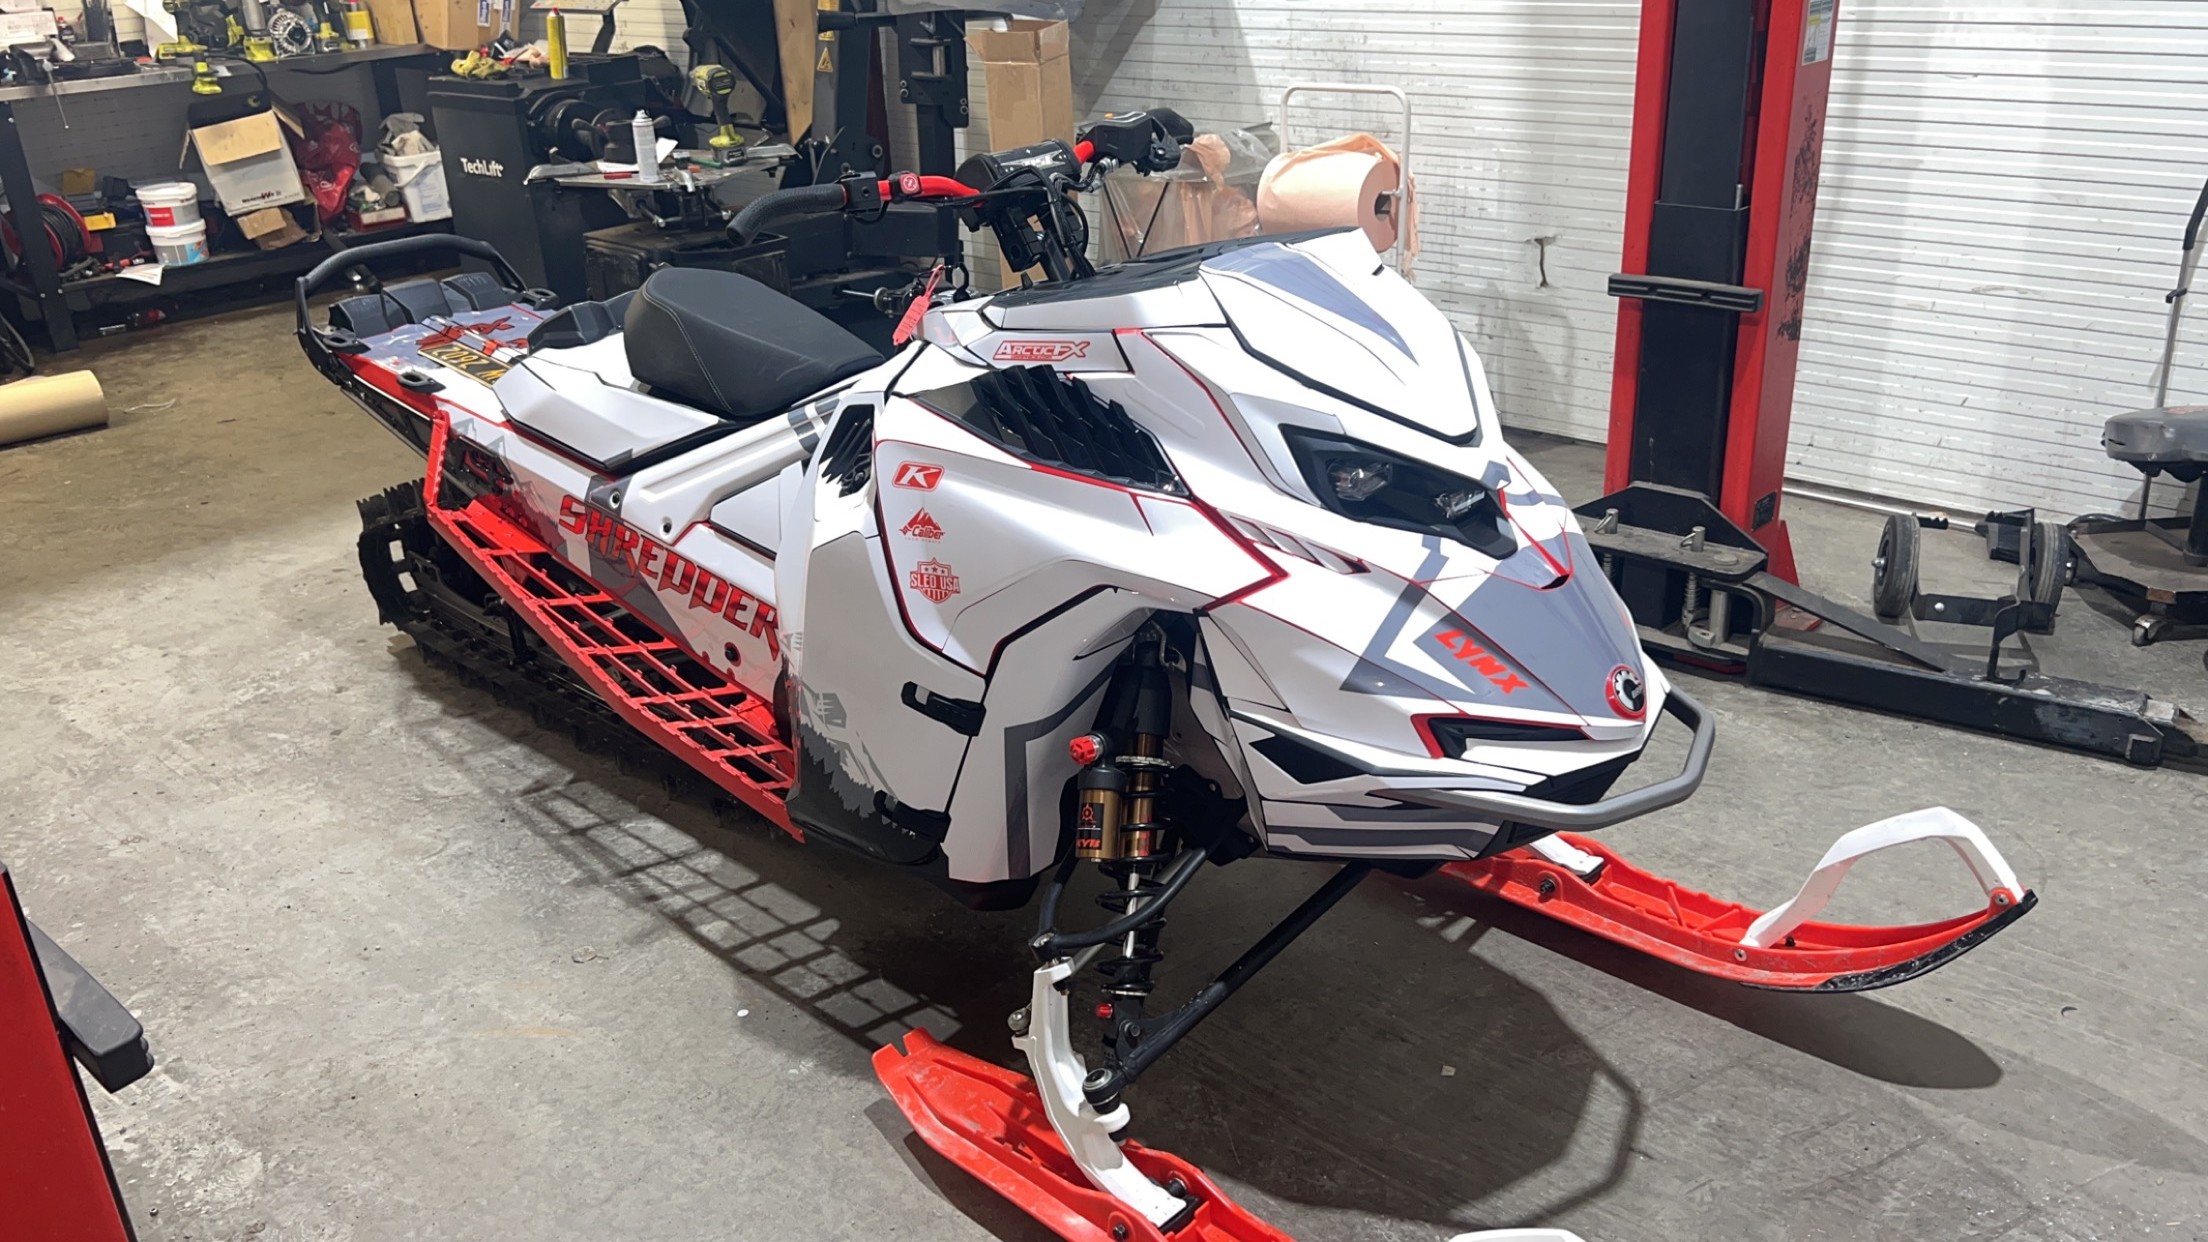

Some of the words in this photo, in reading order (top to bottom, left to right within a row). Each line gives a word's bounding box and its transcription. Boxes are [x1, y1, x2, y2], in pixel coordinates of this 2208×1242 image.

[460, 157, 504, 177] TechLift
[896, 465, 940, 488] K
[911, 525, 944, 540] Caliber
[559, 494, 781, 662] SHREDDER
[910, 573, 937, 588] SLED
[940, 575, 961, 592] USA
[1434, 629, 1531, 695] LYNX
